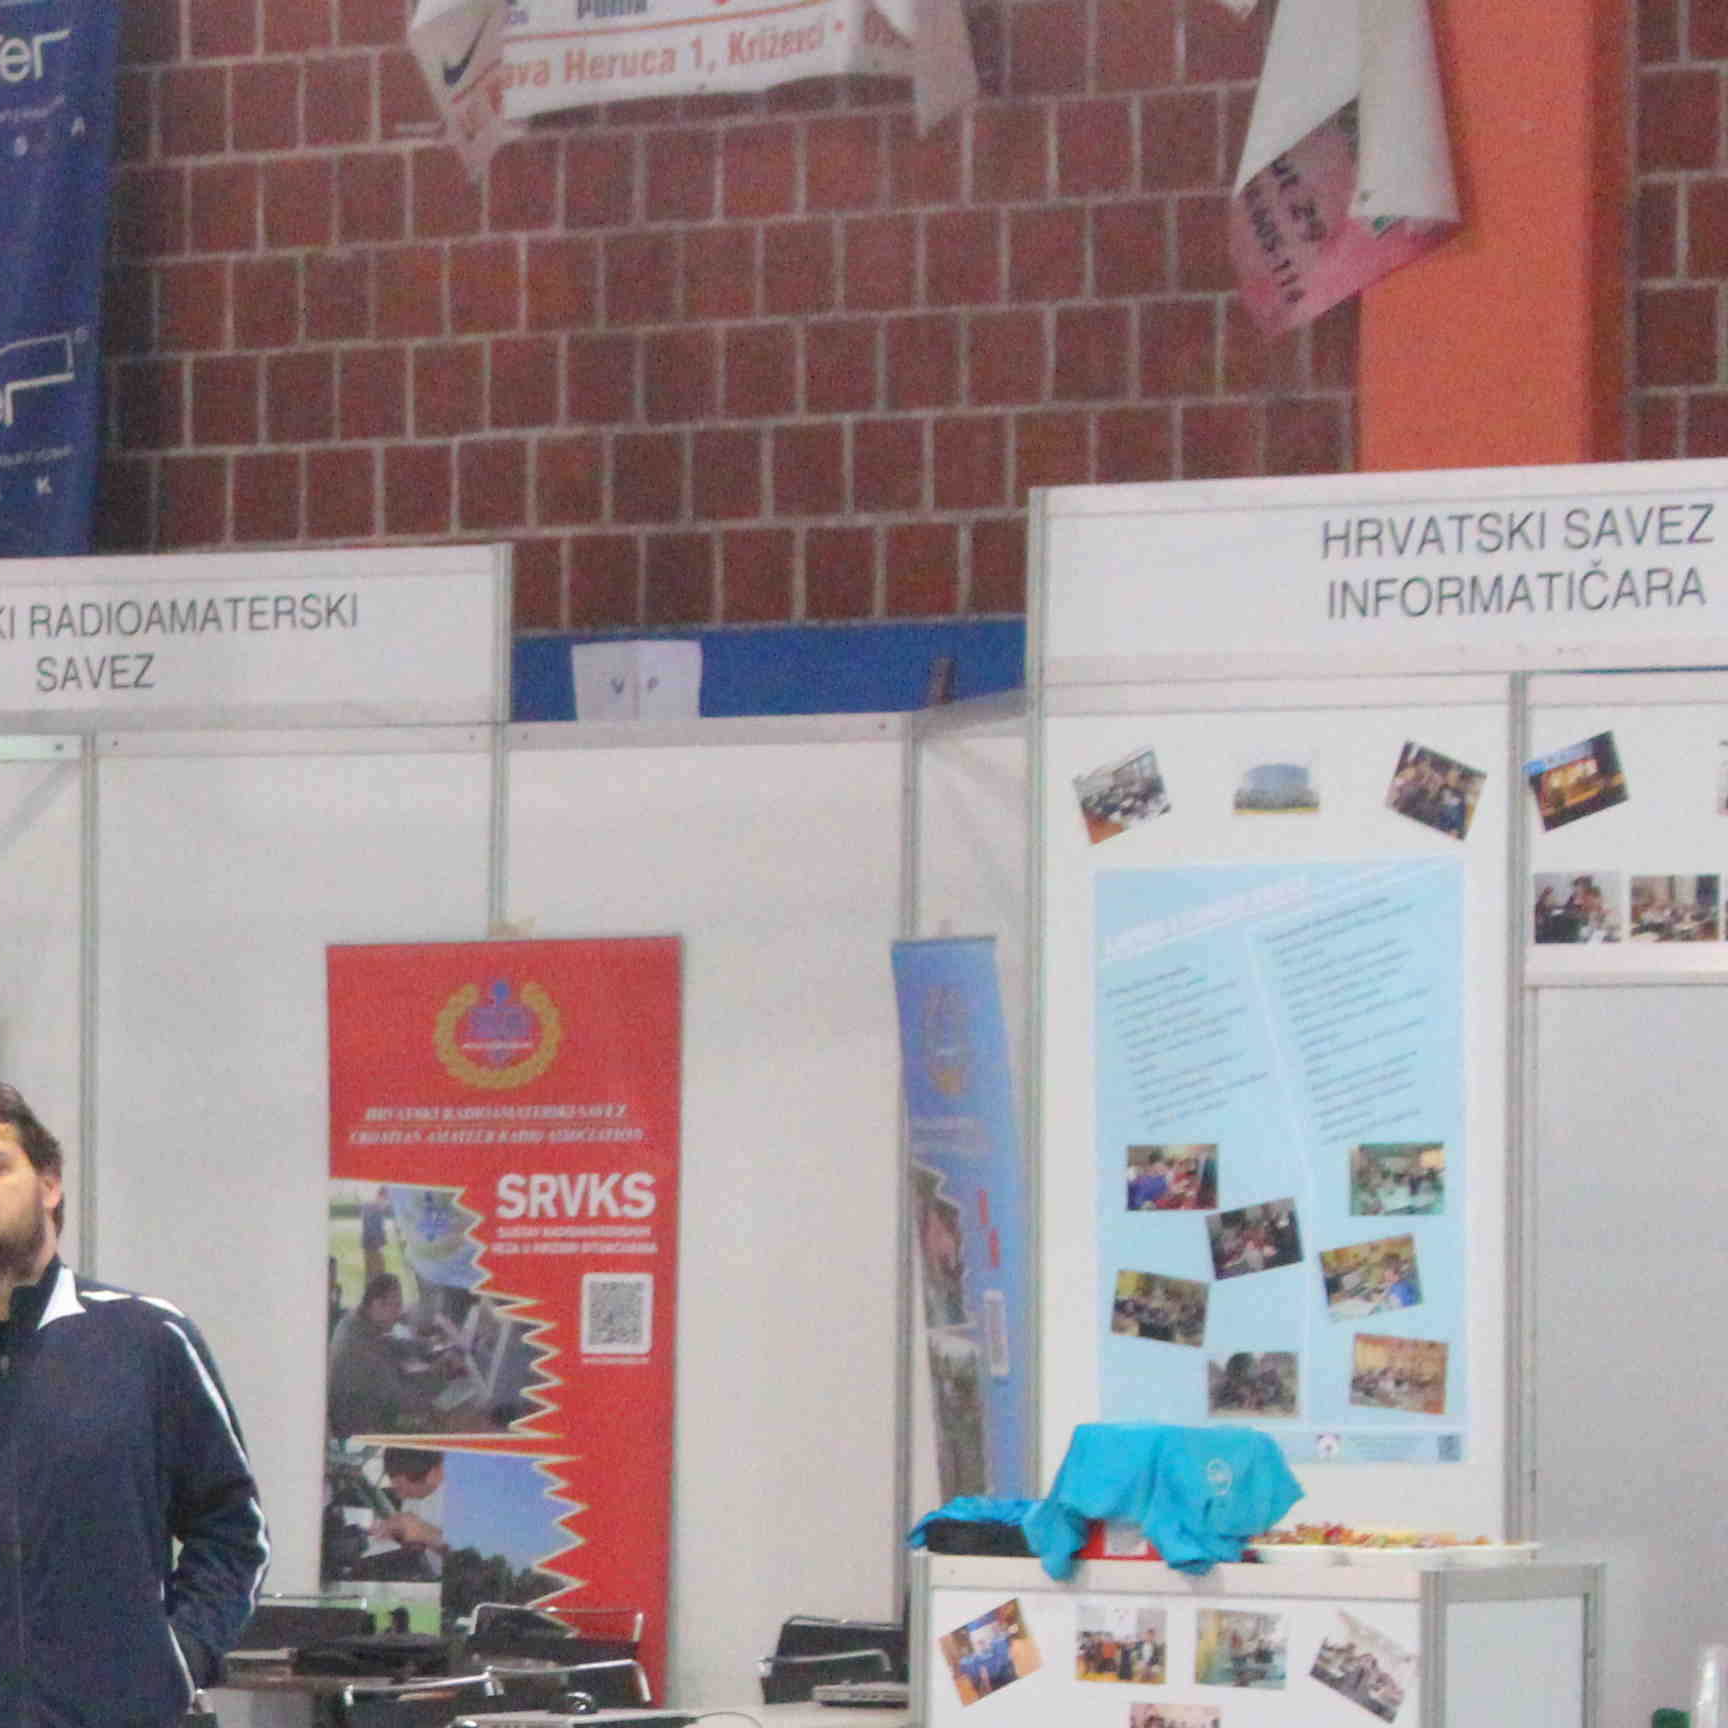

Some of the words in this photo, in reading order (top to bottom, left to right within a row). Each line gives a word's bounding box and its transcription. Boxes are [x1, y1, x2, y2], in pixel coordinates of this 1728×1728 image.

[1321, 510, 1546, 560] HRVATSKI
[1563, 503, 1715, 551] SAVEZ
[1327, 560, 1708, 620] INFORMATIČARA
[30, 594, 359, 640] RADIOAMATERSKI
[35, 653, 157, 693] SAVEZ
[496, 1170, 658, 1220] SRVKS
